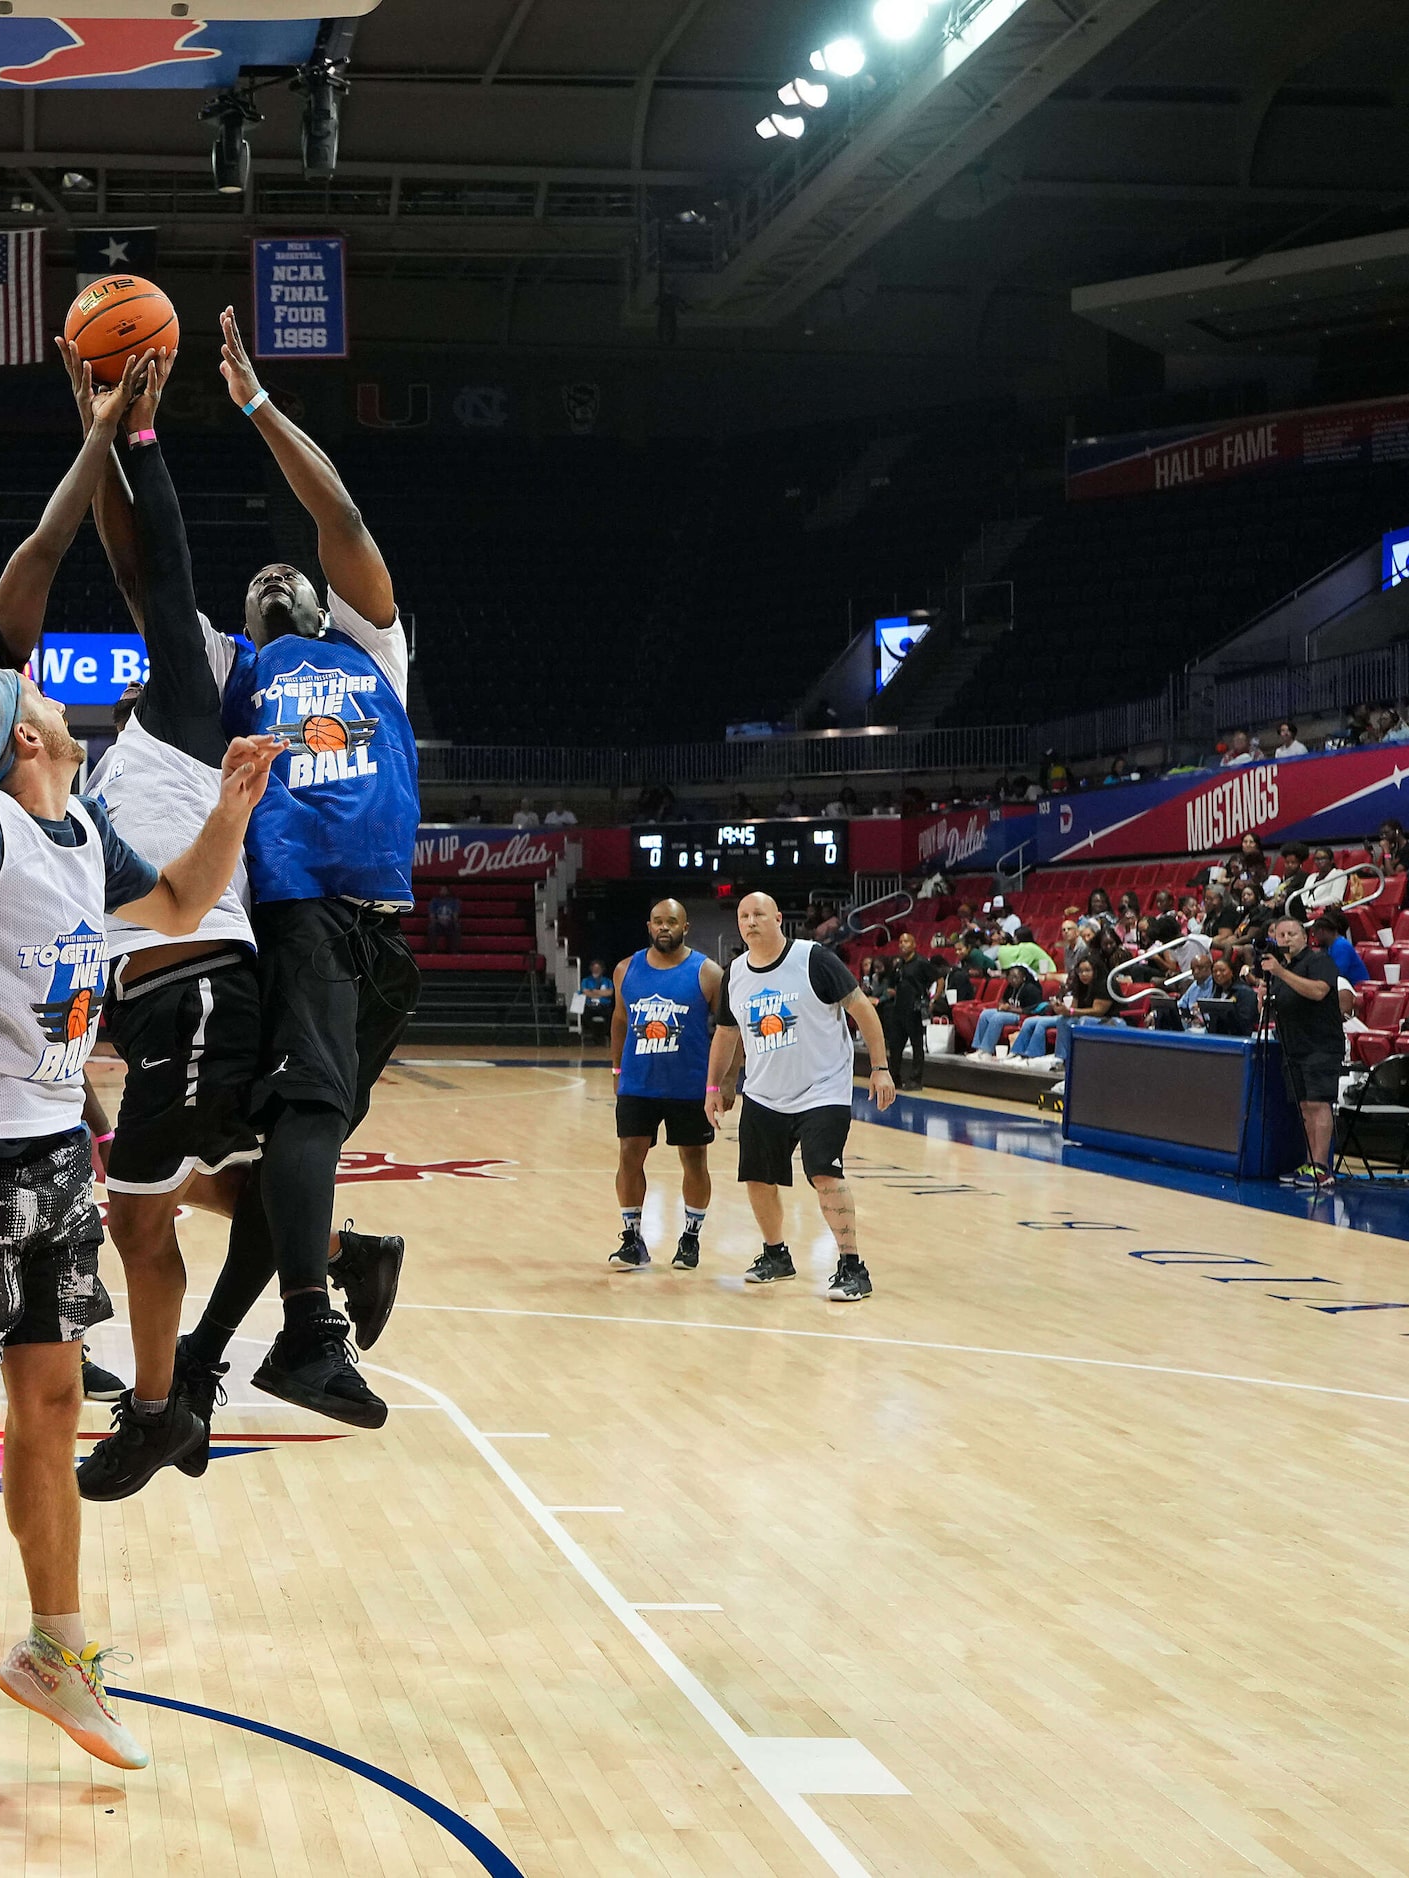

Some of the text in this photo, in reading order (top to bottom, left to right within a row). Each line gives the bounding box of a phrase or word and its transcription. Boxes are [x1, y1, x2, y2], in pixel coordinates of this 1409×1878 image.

[273, 265, 326, 281] NCAA
[78, 279, 135, 312] ELITE
[270, 285, 329, 302] FINAL
[274, 305, 326, 323] FOUR
[274, 328, 327, 348] 1956
[1155, 447, 1204, 490] HALL
[1205, 447, 1219, 468] OF
[1223, 423, 1278, 470] FAME
[39, 648, 150, 683] We Ba
[251, 676, 377, 709] TOGETHER
[298, 694, 344, 715] WE
[288, 745, 378, 789] BALL
[1039, 802, 1051, 815] 103
[1186, 764, 1279, 852] MUSTANGS
[718, 826, 756, 846] 19:45
[945, 816, 988, 868] Dallas
[414, 833, 552, 877] NY UP Dallas
[650, 848, 661, 867] 0
[825, 844, 837, 864] 0
[19, 942, 109, 968] TOGETH
[70, 963, 101, 989] WE
[629, 1003, 690, 1014] TOGETHER
[739, 992, 800, 1010] TOGETHER
[635, 1034, 679, 1055] BALL
[754, 1028, 798, 1055] BALL
